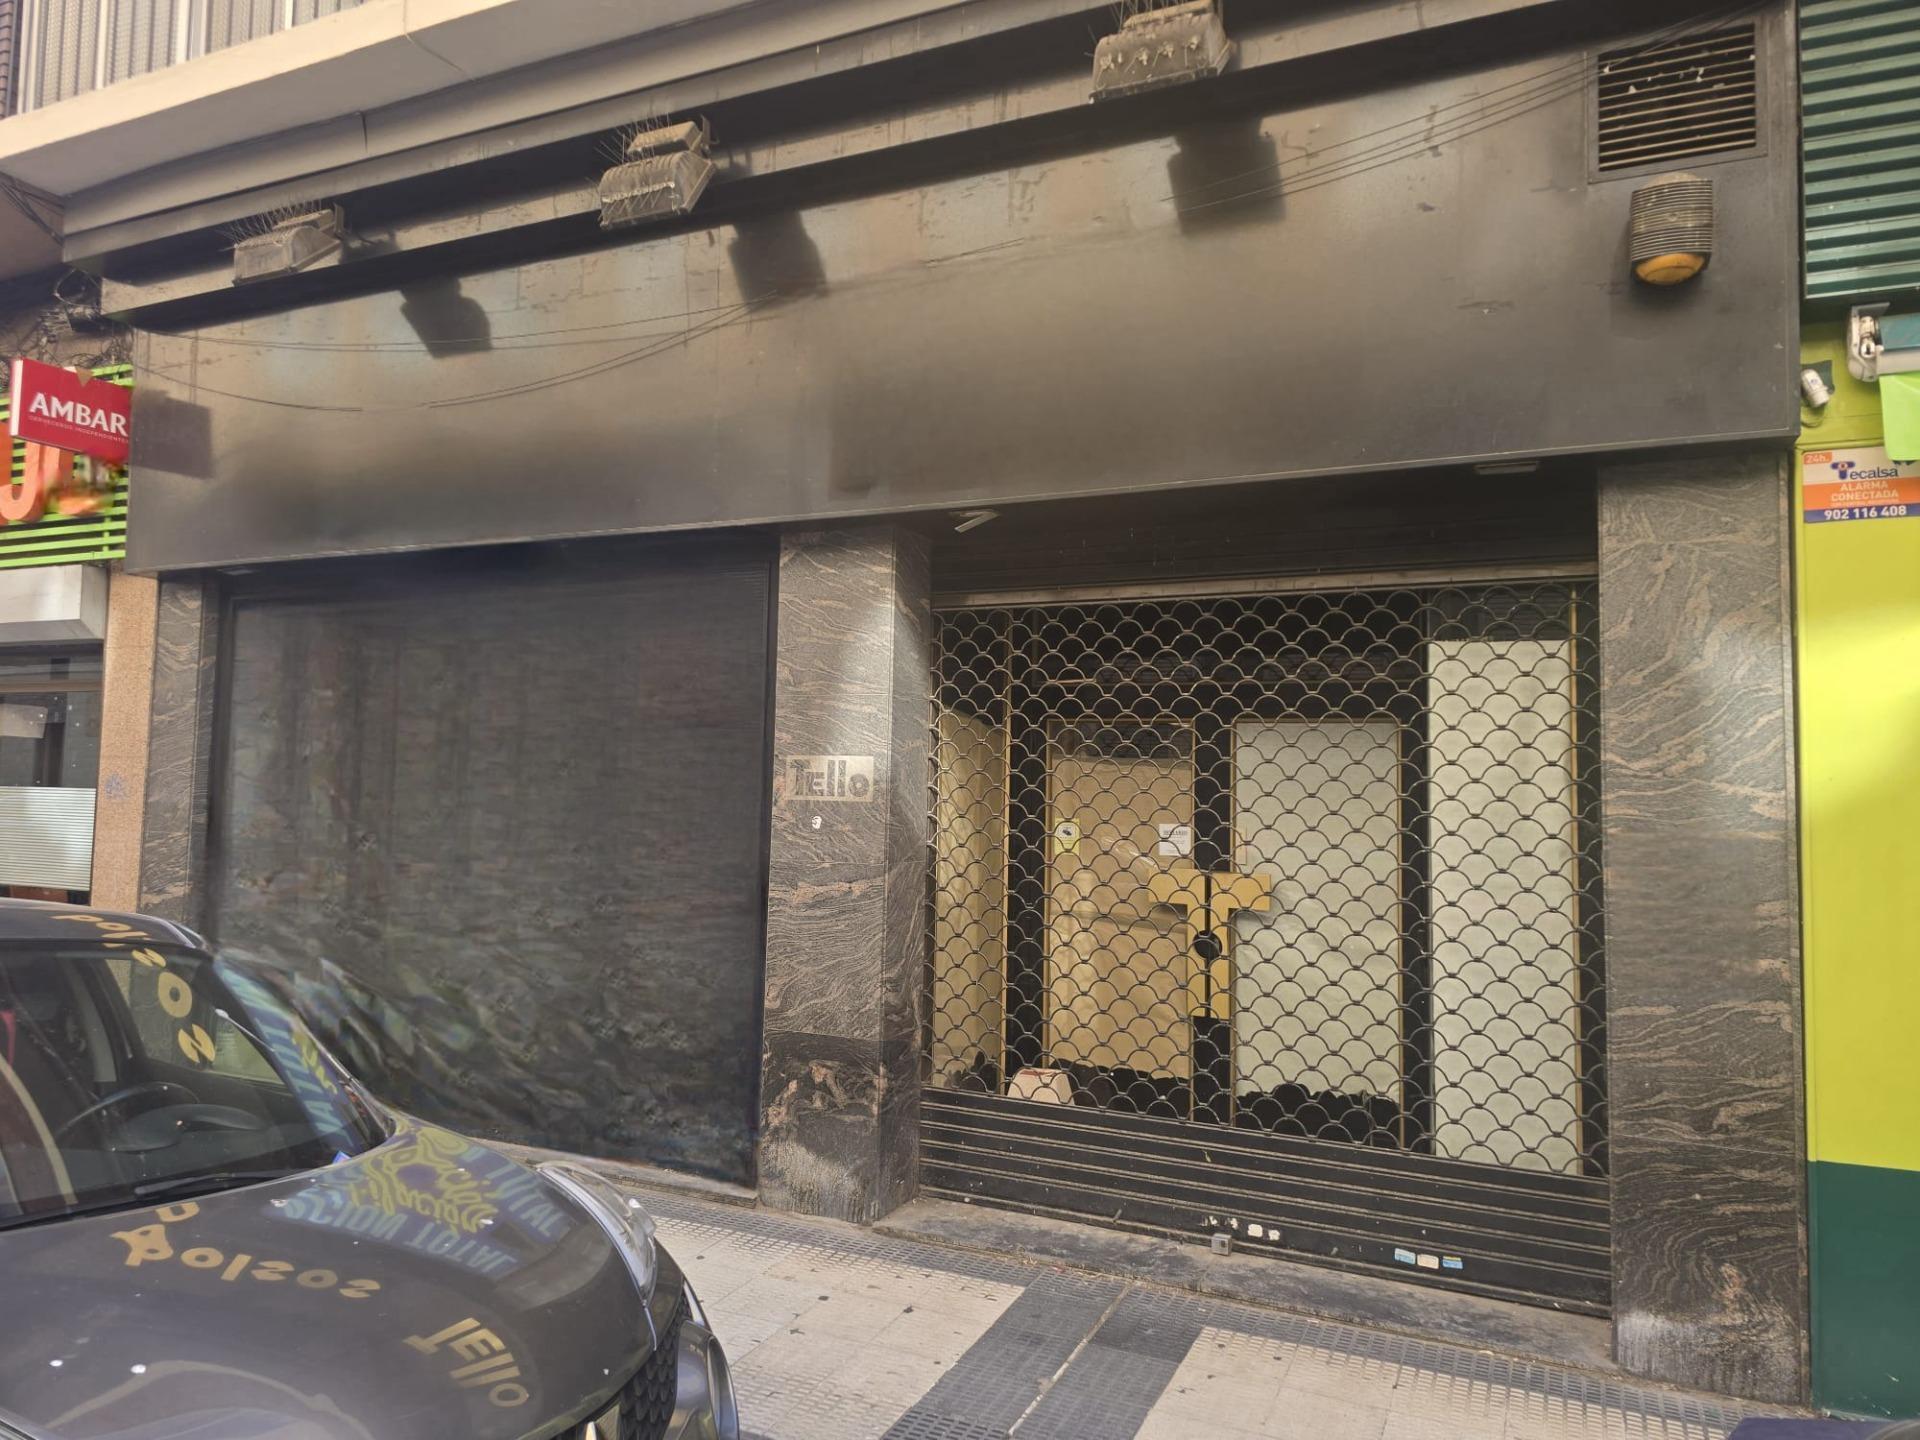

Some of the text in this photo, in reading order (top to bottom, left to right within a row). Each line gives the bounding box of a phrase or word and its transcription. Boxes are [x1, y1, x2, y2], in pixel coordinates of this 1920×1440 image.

[30, 391, 129, 437] AMBAR
[1830, 461, 1899, 480] Tecalsa
[1840, 480, 1888, 492] ALARMA
[1831, 490, 1899, 501] CONECTADA
[1824, 505, 1907, 520] 902 116 408
